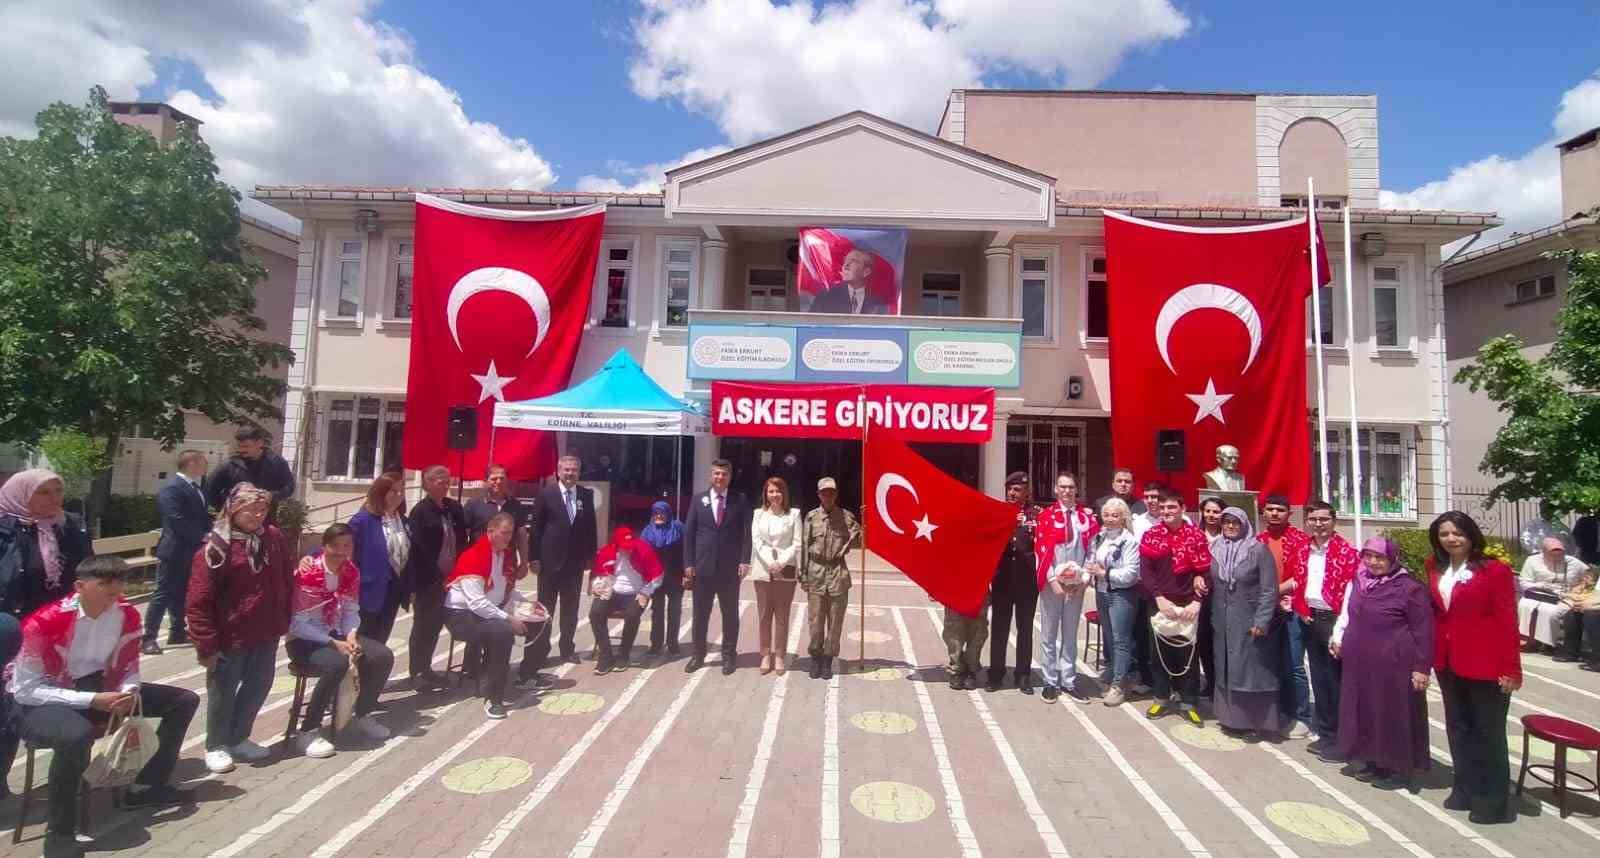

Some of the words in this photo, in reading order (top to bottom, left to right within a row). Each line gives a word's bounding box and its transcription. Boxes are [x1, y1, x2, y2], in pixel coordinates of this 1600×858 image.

[547, 418, 582, 428] EDİRNE
[718, 397, 827, 426] ASKERE
[835, 394, 988, 431] GİDİYORUZ
